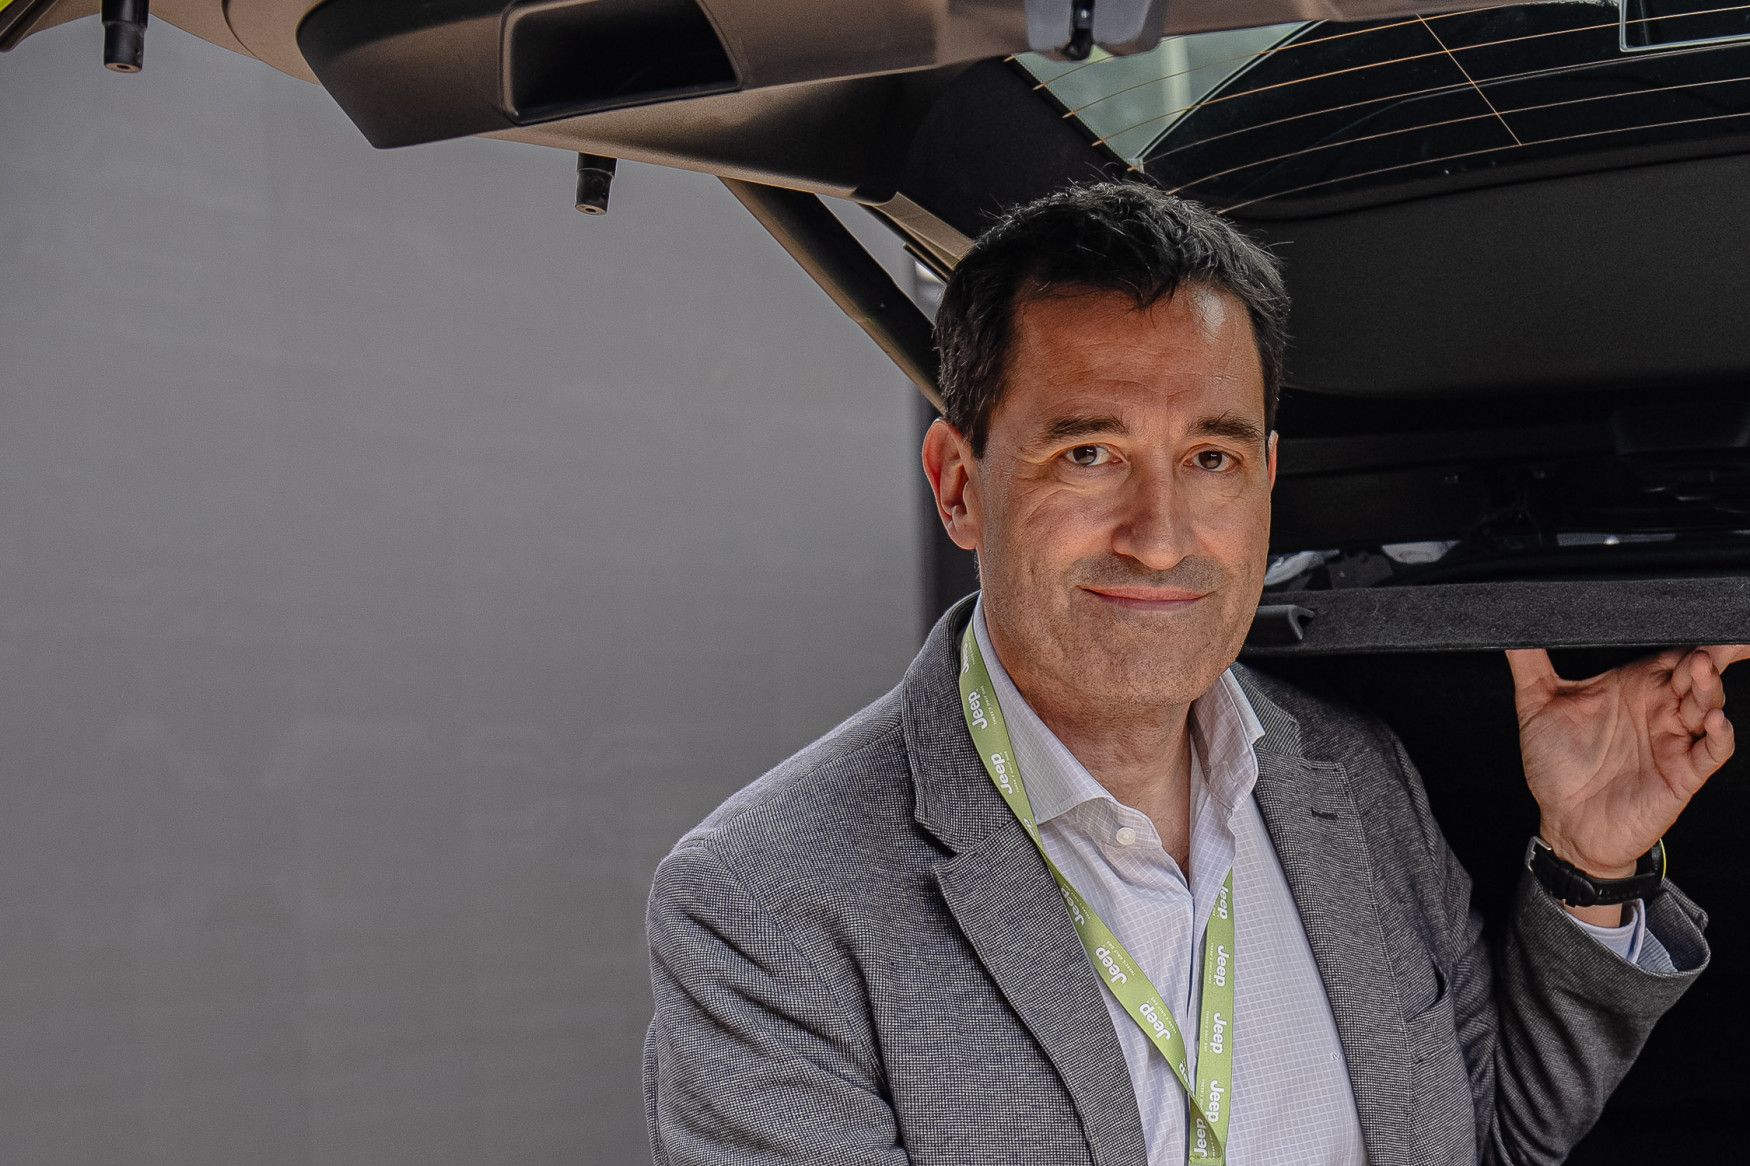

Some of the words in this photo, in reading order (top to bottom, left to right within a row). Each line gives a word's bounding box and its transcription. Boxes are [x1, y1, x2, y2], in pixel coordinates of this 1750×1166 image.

[968, 691, 988, 729] Jeep
[991, 753, 1013, 795] Jeep
[1061, 887, 1085, 926] Jeep
[1095, 947, 1128, 985] Jeep
[1214, 945, 1230, 987] Jeep
[1139, 1003, 1171, 1040] Jeep
[1210, 1012, 1227, 1054] Jeep
[1205, 1080, 1224, 1122] Jeep
[1194, 1118, 1208, 1158] Jeep
